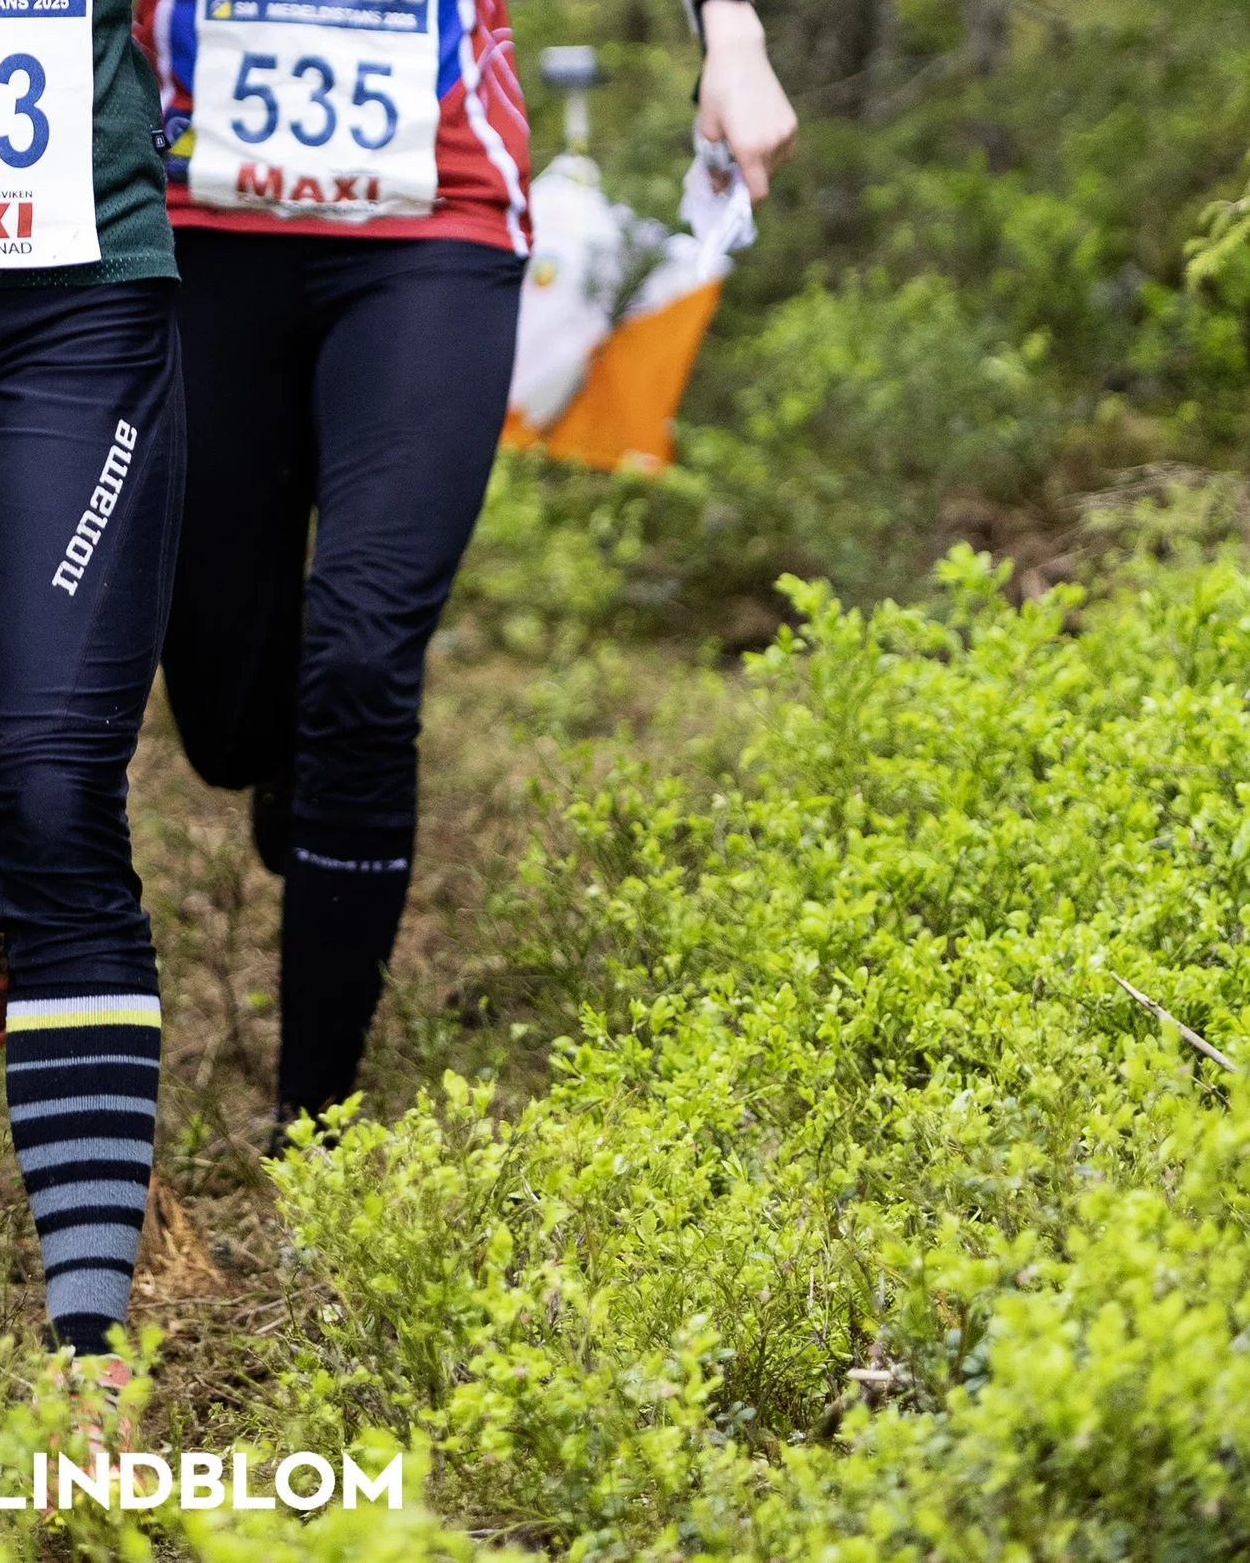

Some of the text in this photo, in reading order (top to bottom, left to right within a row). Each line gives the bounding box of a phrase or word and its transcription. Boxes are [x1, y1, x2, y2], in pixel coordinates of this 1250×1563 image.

[230, 51, 399, 151] 535
[236, 161, 380, 203] MAXI
[51, 418, 138, 597] noname
